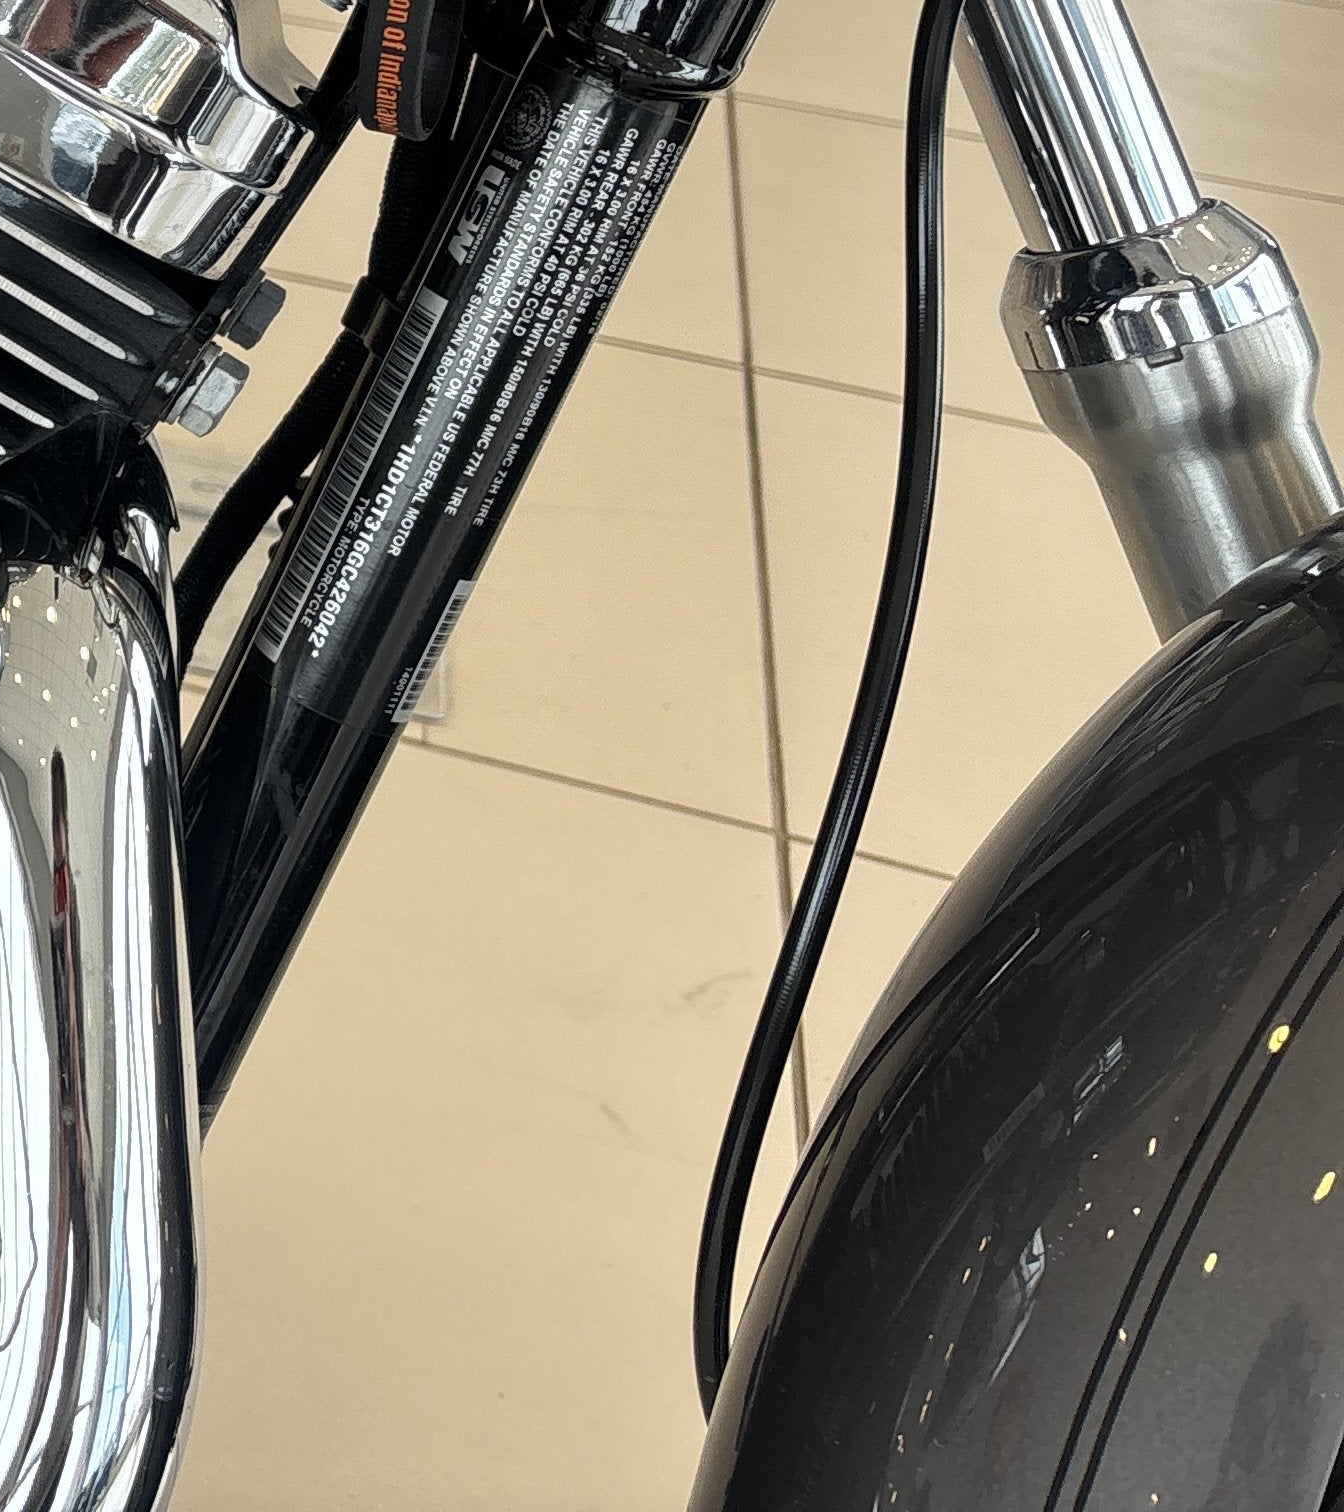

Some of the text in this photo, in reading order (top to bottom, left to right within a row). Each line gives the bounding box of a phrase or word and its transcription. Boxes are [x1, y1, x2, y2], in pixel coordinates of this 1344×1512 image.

[381, 25, 408, 51] of
[552, 102, 576, 130] THE
[533, 129, 563, 172] DATE
[610, 128, 639, 171] GAWR
[639, 138, 668, 181] GAWR
[648, 142, 677, 188] GVWR:
[526, 168, 545, 193] OF
[590, 171, 619, 211] REAR
[617, 182, 647, 230] FRONT
[575, 218, 596, 244] 302
[623, 212, 642, 236] KG
[443, 109, 592, 401] VEHICLE SAFETY STANDARDS IN EFFECT ON
[474, 189, 533, 295] MANUFACTURE
[512, 149, 611, 337] 16 X 3.00 RIM AT 40 PSI COLD
[543, 160, 641, 348] 16 X 3.00 RIM AT 36 PSI COLD
[564, 244, 584, 267] KG
[600, 240, 619, 263] 152
[604, 238, 630, 273] (1000
[550, 267, 572, 297] (665
[590, 264, 607, 285] KG
[536, 297, 559, 321] LB)
[575, 286, 597, 315] (335
[386, 111, 609, 557] THIS VEHICLE CONFORMS TO ALL APPLICABLE US FEDERAL MOTOR
[449, 294, 483, 347] SHOWN
[561, 316, 582, 339] LB)
[520, 322, 547, 358] WITH
[426, 345, 460, 395] ABOVE
[545, 341, 570, 375] WITH
[489, 359, 528, 423] 150/80B16
[412, 396, 439, 431] V.I.N.
[476, 423, 497, 450] M/C
[462, 451, 485, 477] 77H
[487, 470, 508, 495] 73H
[443, 486, 469, 517] TIRE
[472, 497, 495, 527] TIRE
[299, 496, 371, 628] TYPE: MOTORCYCLE
